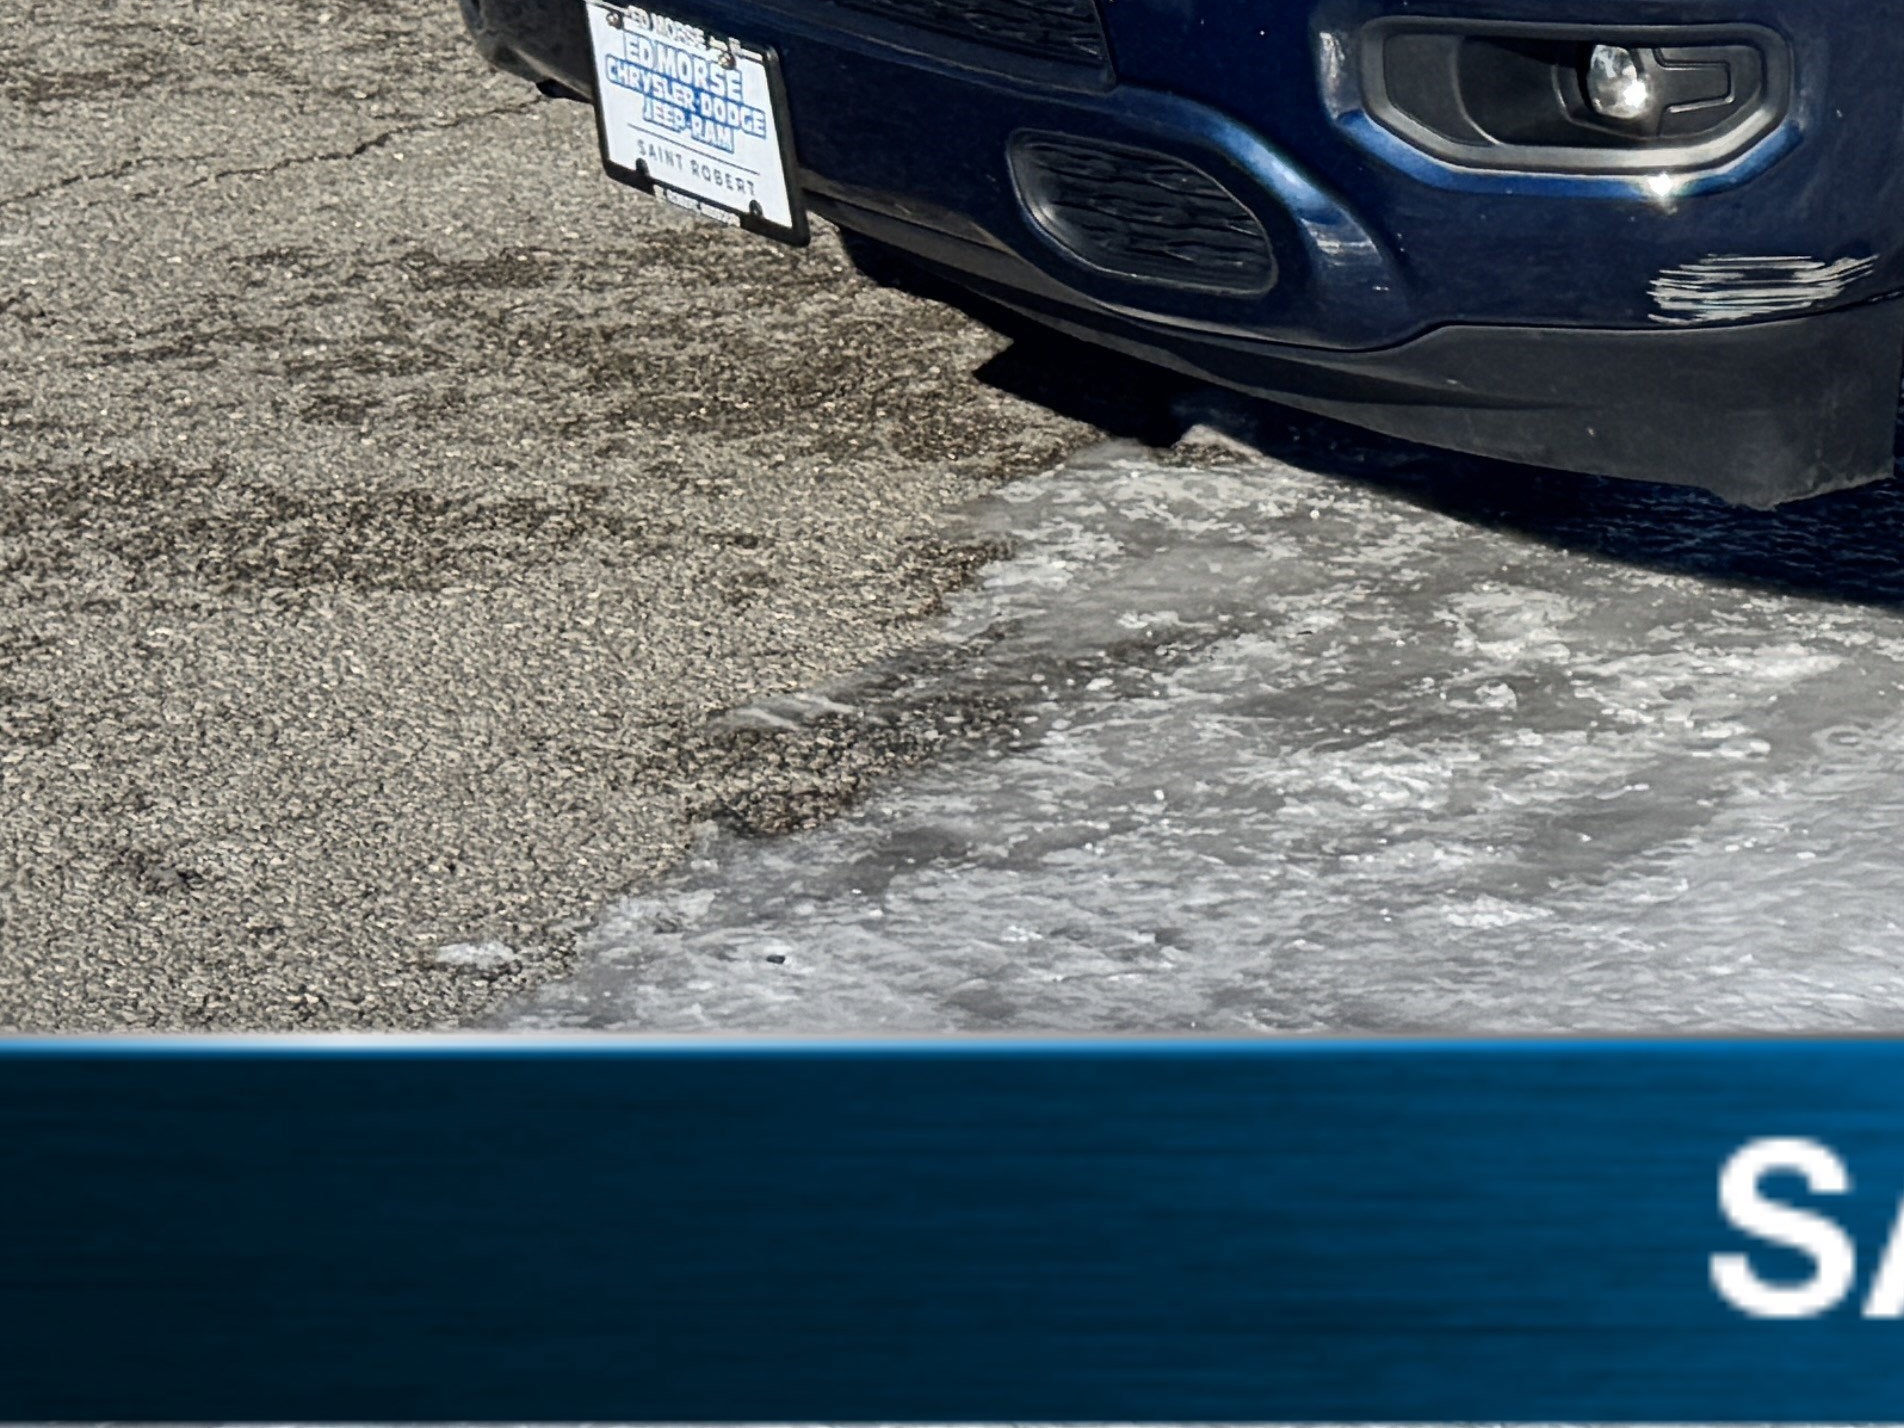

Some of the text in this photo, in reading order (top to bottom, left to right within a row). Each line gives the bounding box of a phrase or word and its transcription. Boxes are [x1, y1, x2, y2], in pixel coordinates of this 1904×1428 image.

[606, 53, 767, 140] CHRYSLER DODGE
[624, 30, 743, 103] ED MORSE
[643, 96, 735, 154] JEEP RAM
[636, 139, 756, 196] SAINT ROBERT
